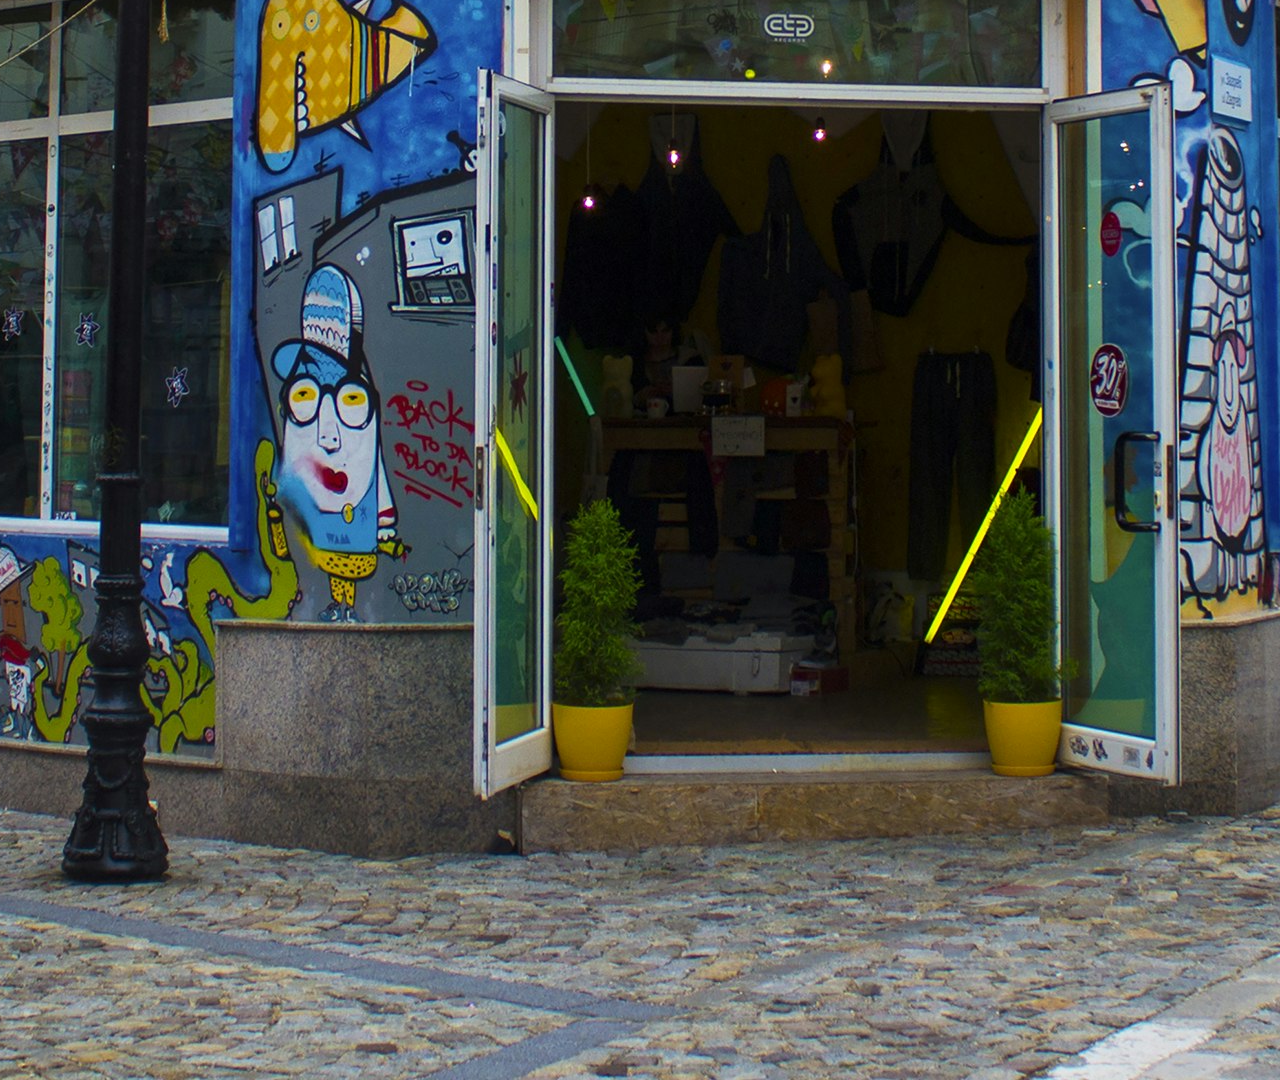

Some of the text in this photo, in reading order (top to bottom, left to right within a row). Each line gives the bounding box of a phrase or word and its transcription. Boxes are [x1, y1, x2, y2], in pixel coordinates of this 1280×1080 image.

[387, 389, 474, 437] BACK
[394, 443, 473, 498] BLOCK
[412, 433, 473, 468] TO DA
